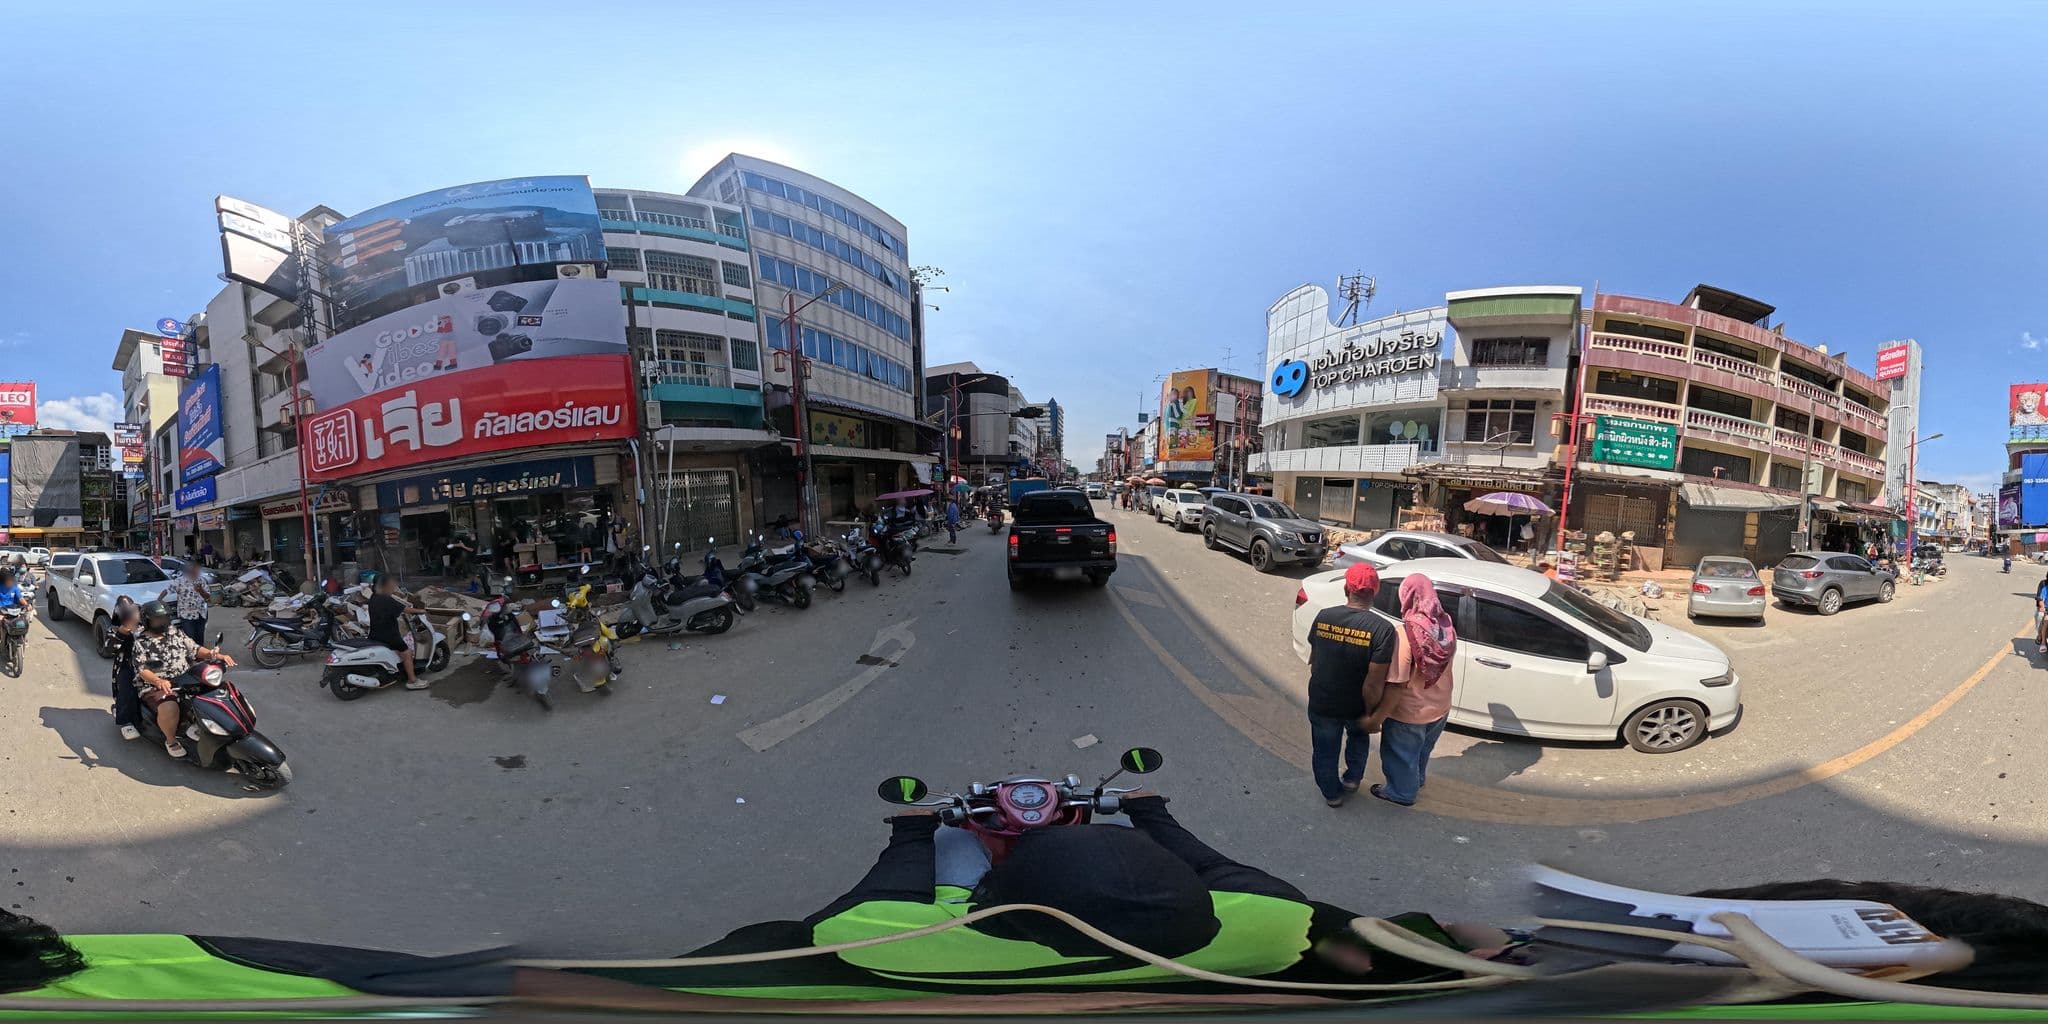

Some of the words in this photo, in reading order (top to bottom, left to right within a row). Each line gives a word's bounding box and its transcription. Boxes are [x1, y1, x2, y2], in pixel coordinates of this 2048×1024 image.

[376, 314, 438, 348] Good
[1312, 331, 1440, 372] แว่นท็อปเจริญ
[1310, 372, 1338, 389] TOP
[1341, 353, 1436, 383] CHAROEN
[0, 394, 27, 403] LEO
[364, 390, 463, 460] เจีย
[474, 401, 620, 439] คัลเลอร์แลบ
[1331, 625, 1344, 634] YOU
[1351, 629, 1366, 638] FIND
[1366, 631, 1371, 640] A
